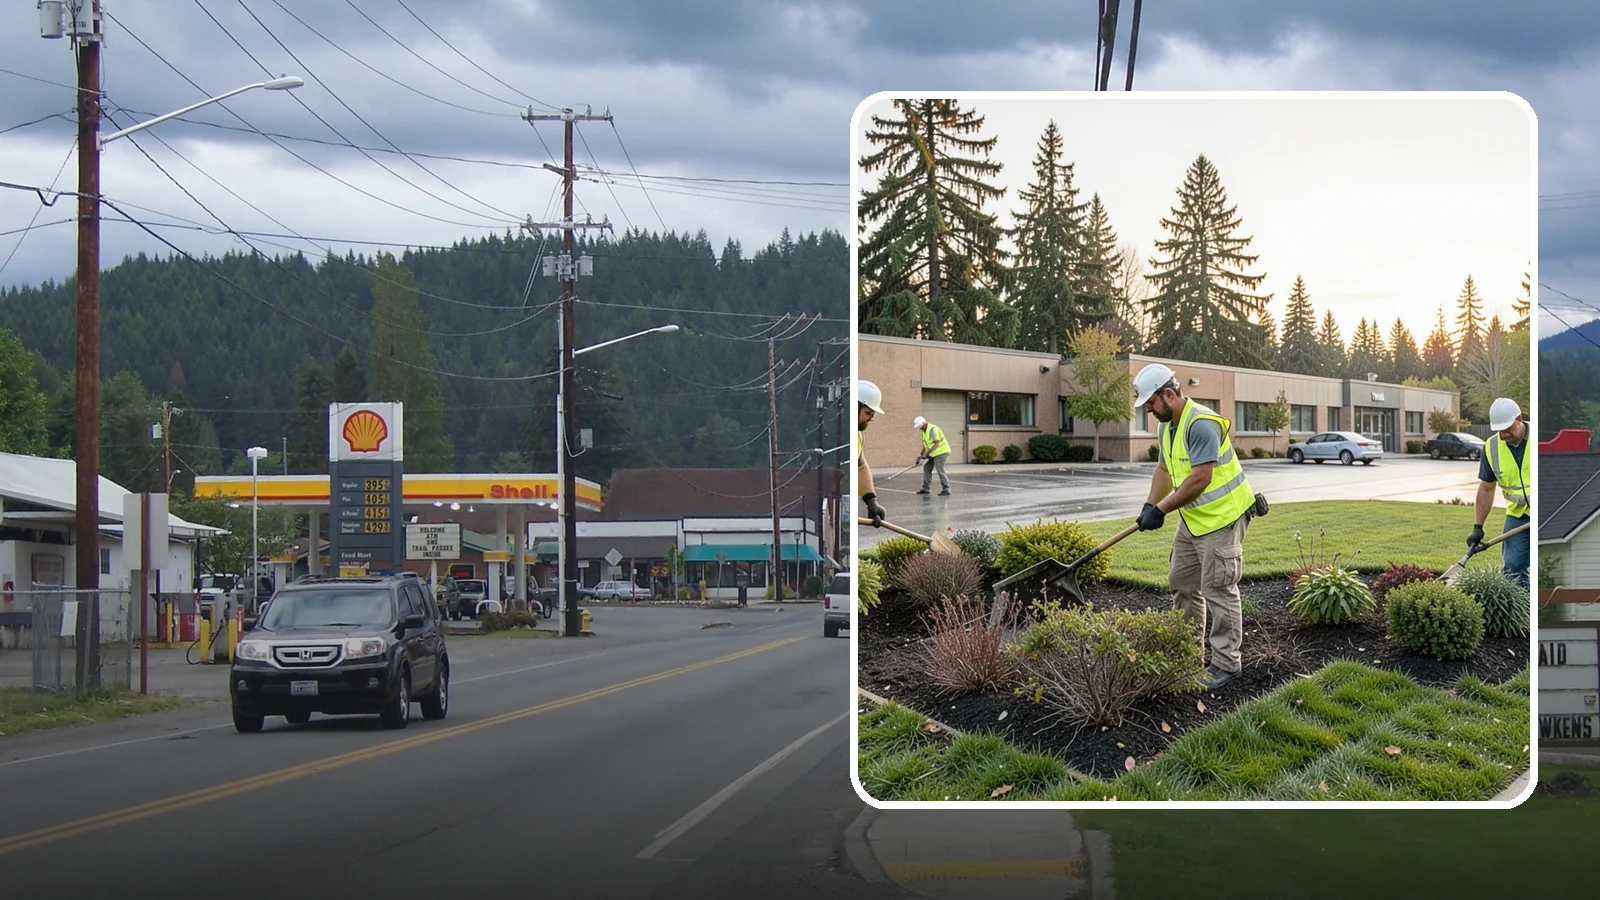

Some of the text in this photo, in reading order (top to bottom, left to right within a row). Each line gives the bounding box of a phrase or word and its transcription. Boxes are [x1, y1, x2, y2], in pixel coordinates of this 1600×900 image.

[366, 480, 383, 490] 395
[490, 484, 547, 499] Shell
[366, 494, 383, 504] 405
[366, 508, 383, 518] 415
[366, 522, 383, 533] 429
[1538, 643, 1567, 665] AID
